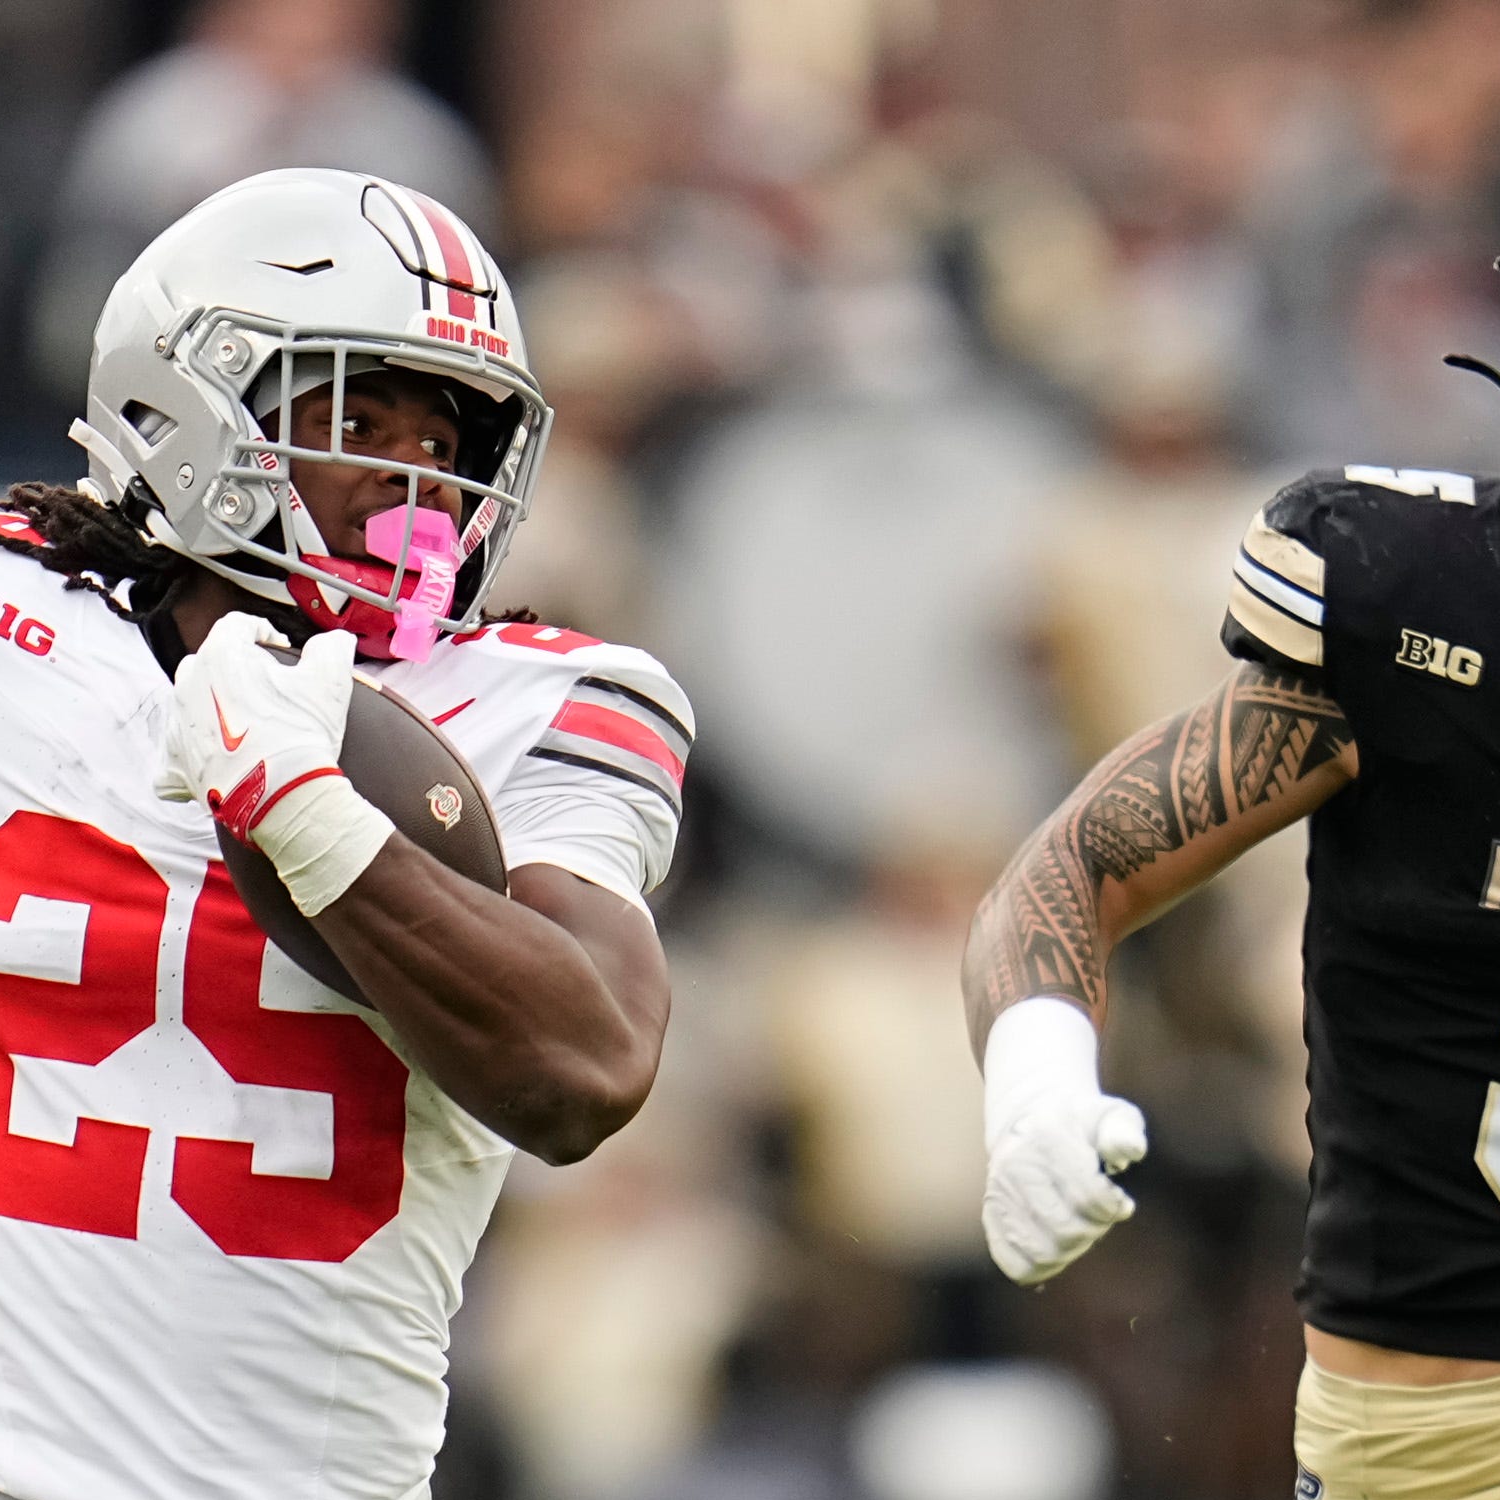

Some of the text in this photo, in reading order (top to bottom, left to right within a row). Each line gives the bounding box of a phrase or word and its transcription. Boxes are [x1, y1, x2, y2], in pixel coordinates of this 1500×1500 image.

[427, 317, 509, 357] OHIO STATE
[463, 524, 482, 556] OHIO
[419, 555, 455, 614] NXTR
